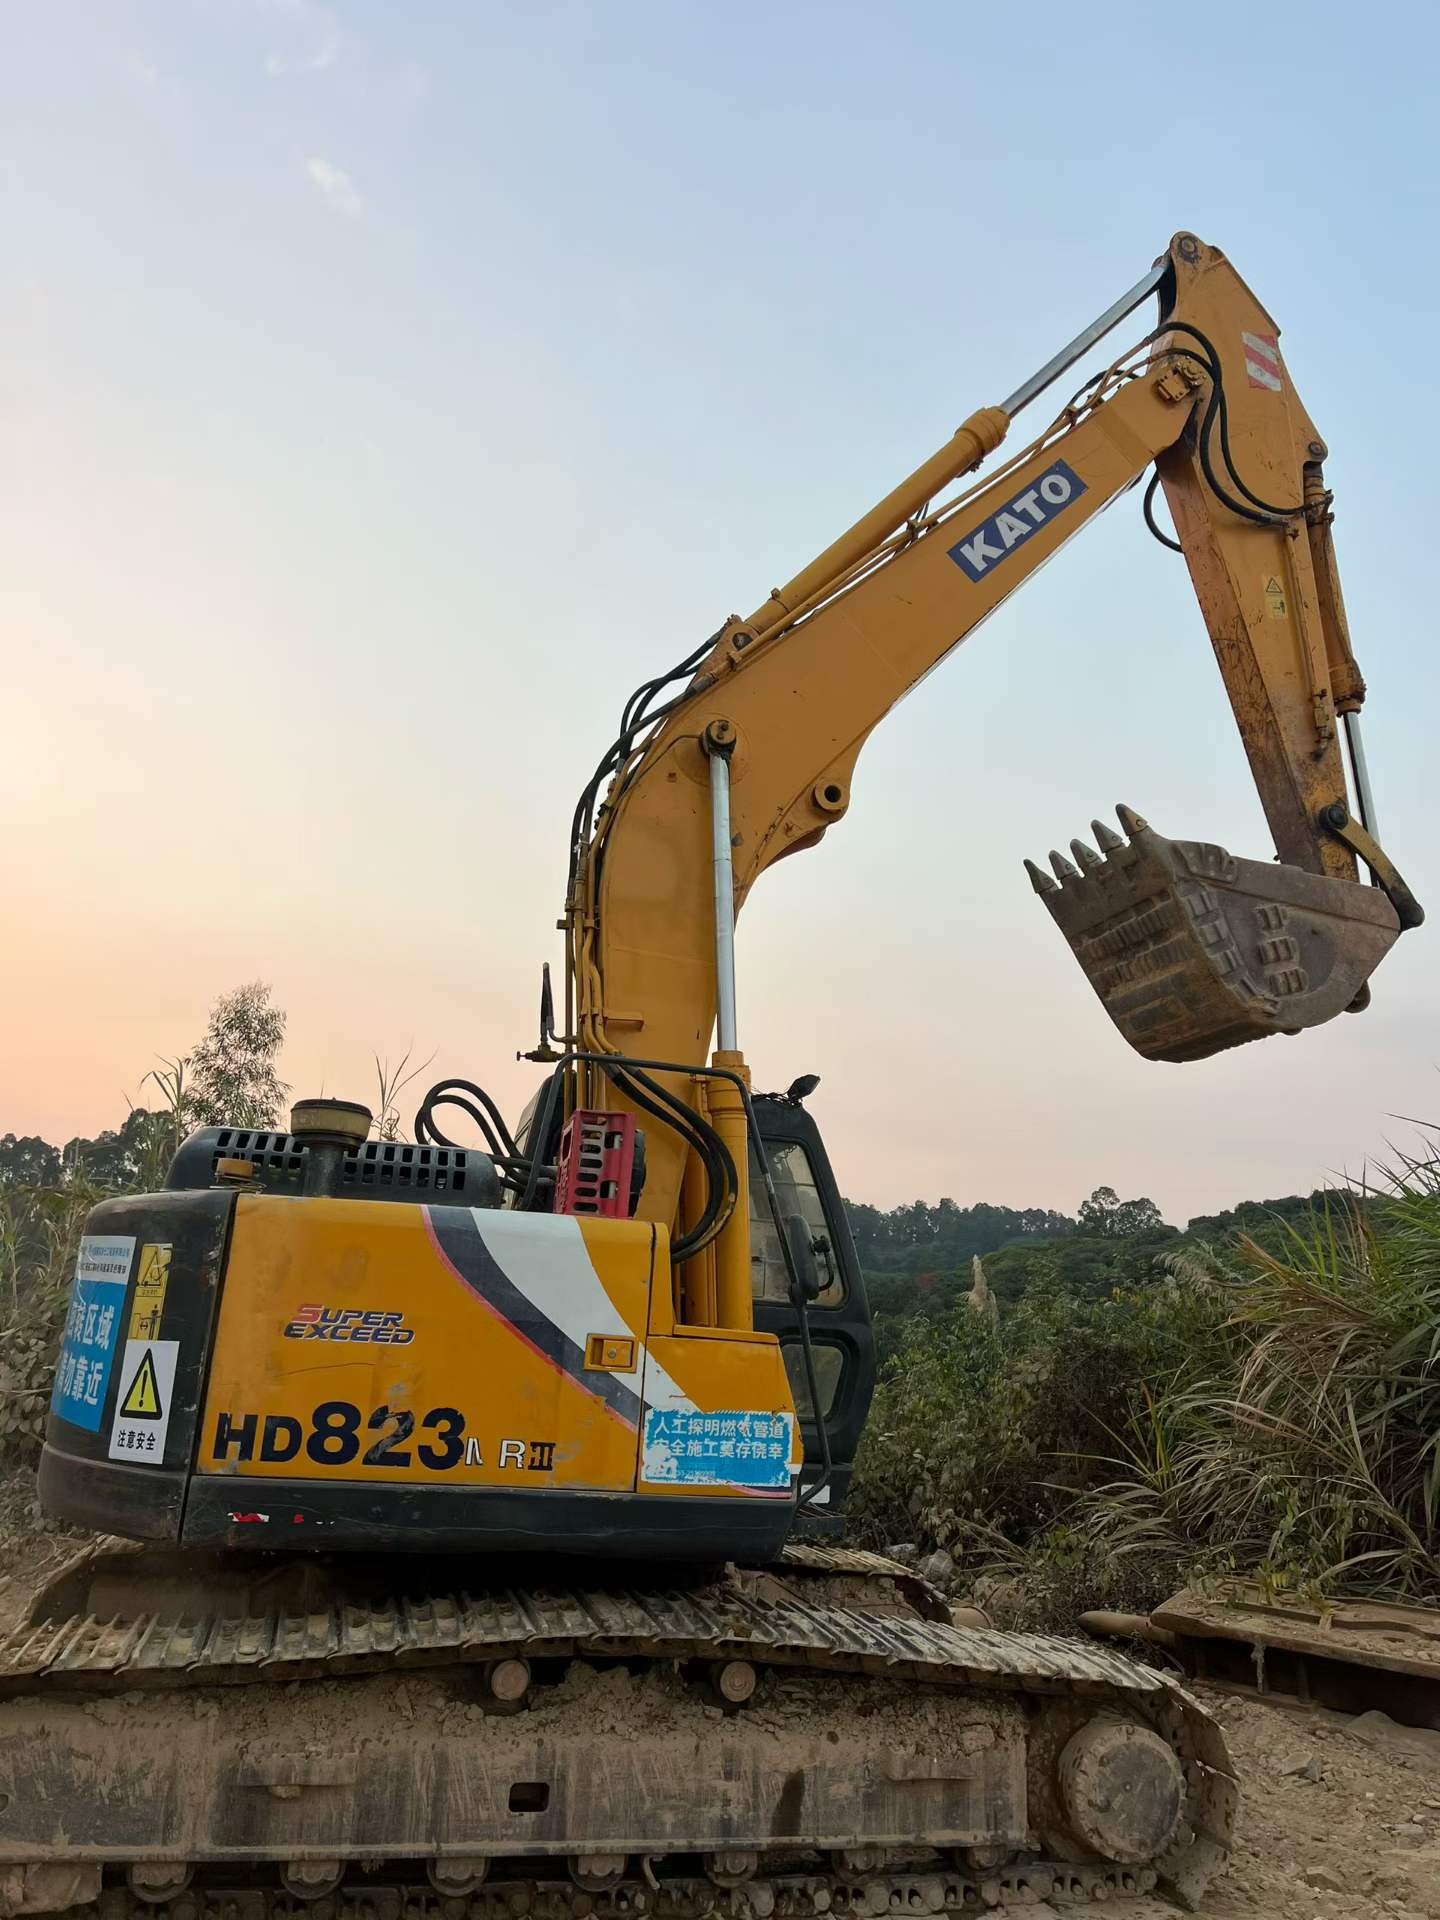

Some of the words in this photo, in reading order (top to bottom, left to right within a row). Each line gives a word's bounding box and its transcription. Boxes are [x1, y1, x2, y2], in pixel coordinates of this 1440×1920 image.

[960, 474, 1072, 572] KATO
[291, 1304, 404, 1328] SUPER
[284, 1322, 415, 1345] EXCEED
[117, 1430, 156, 1451] 注意安全
[213, 1401, 466, 1471] HD823
